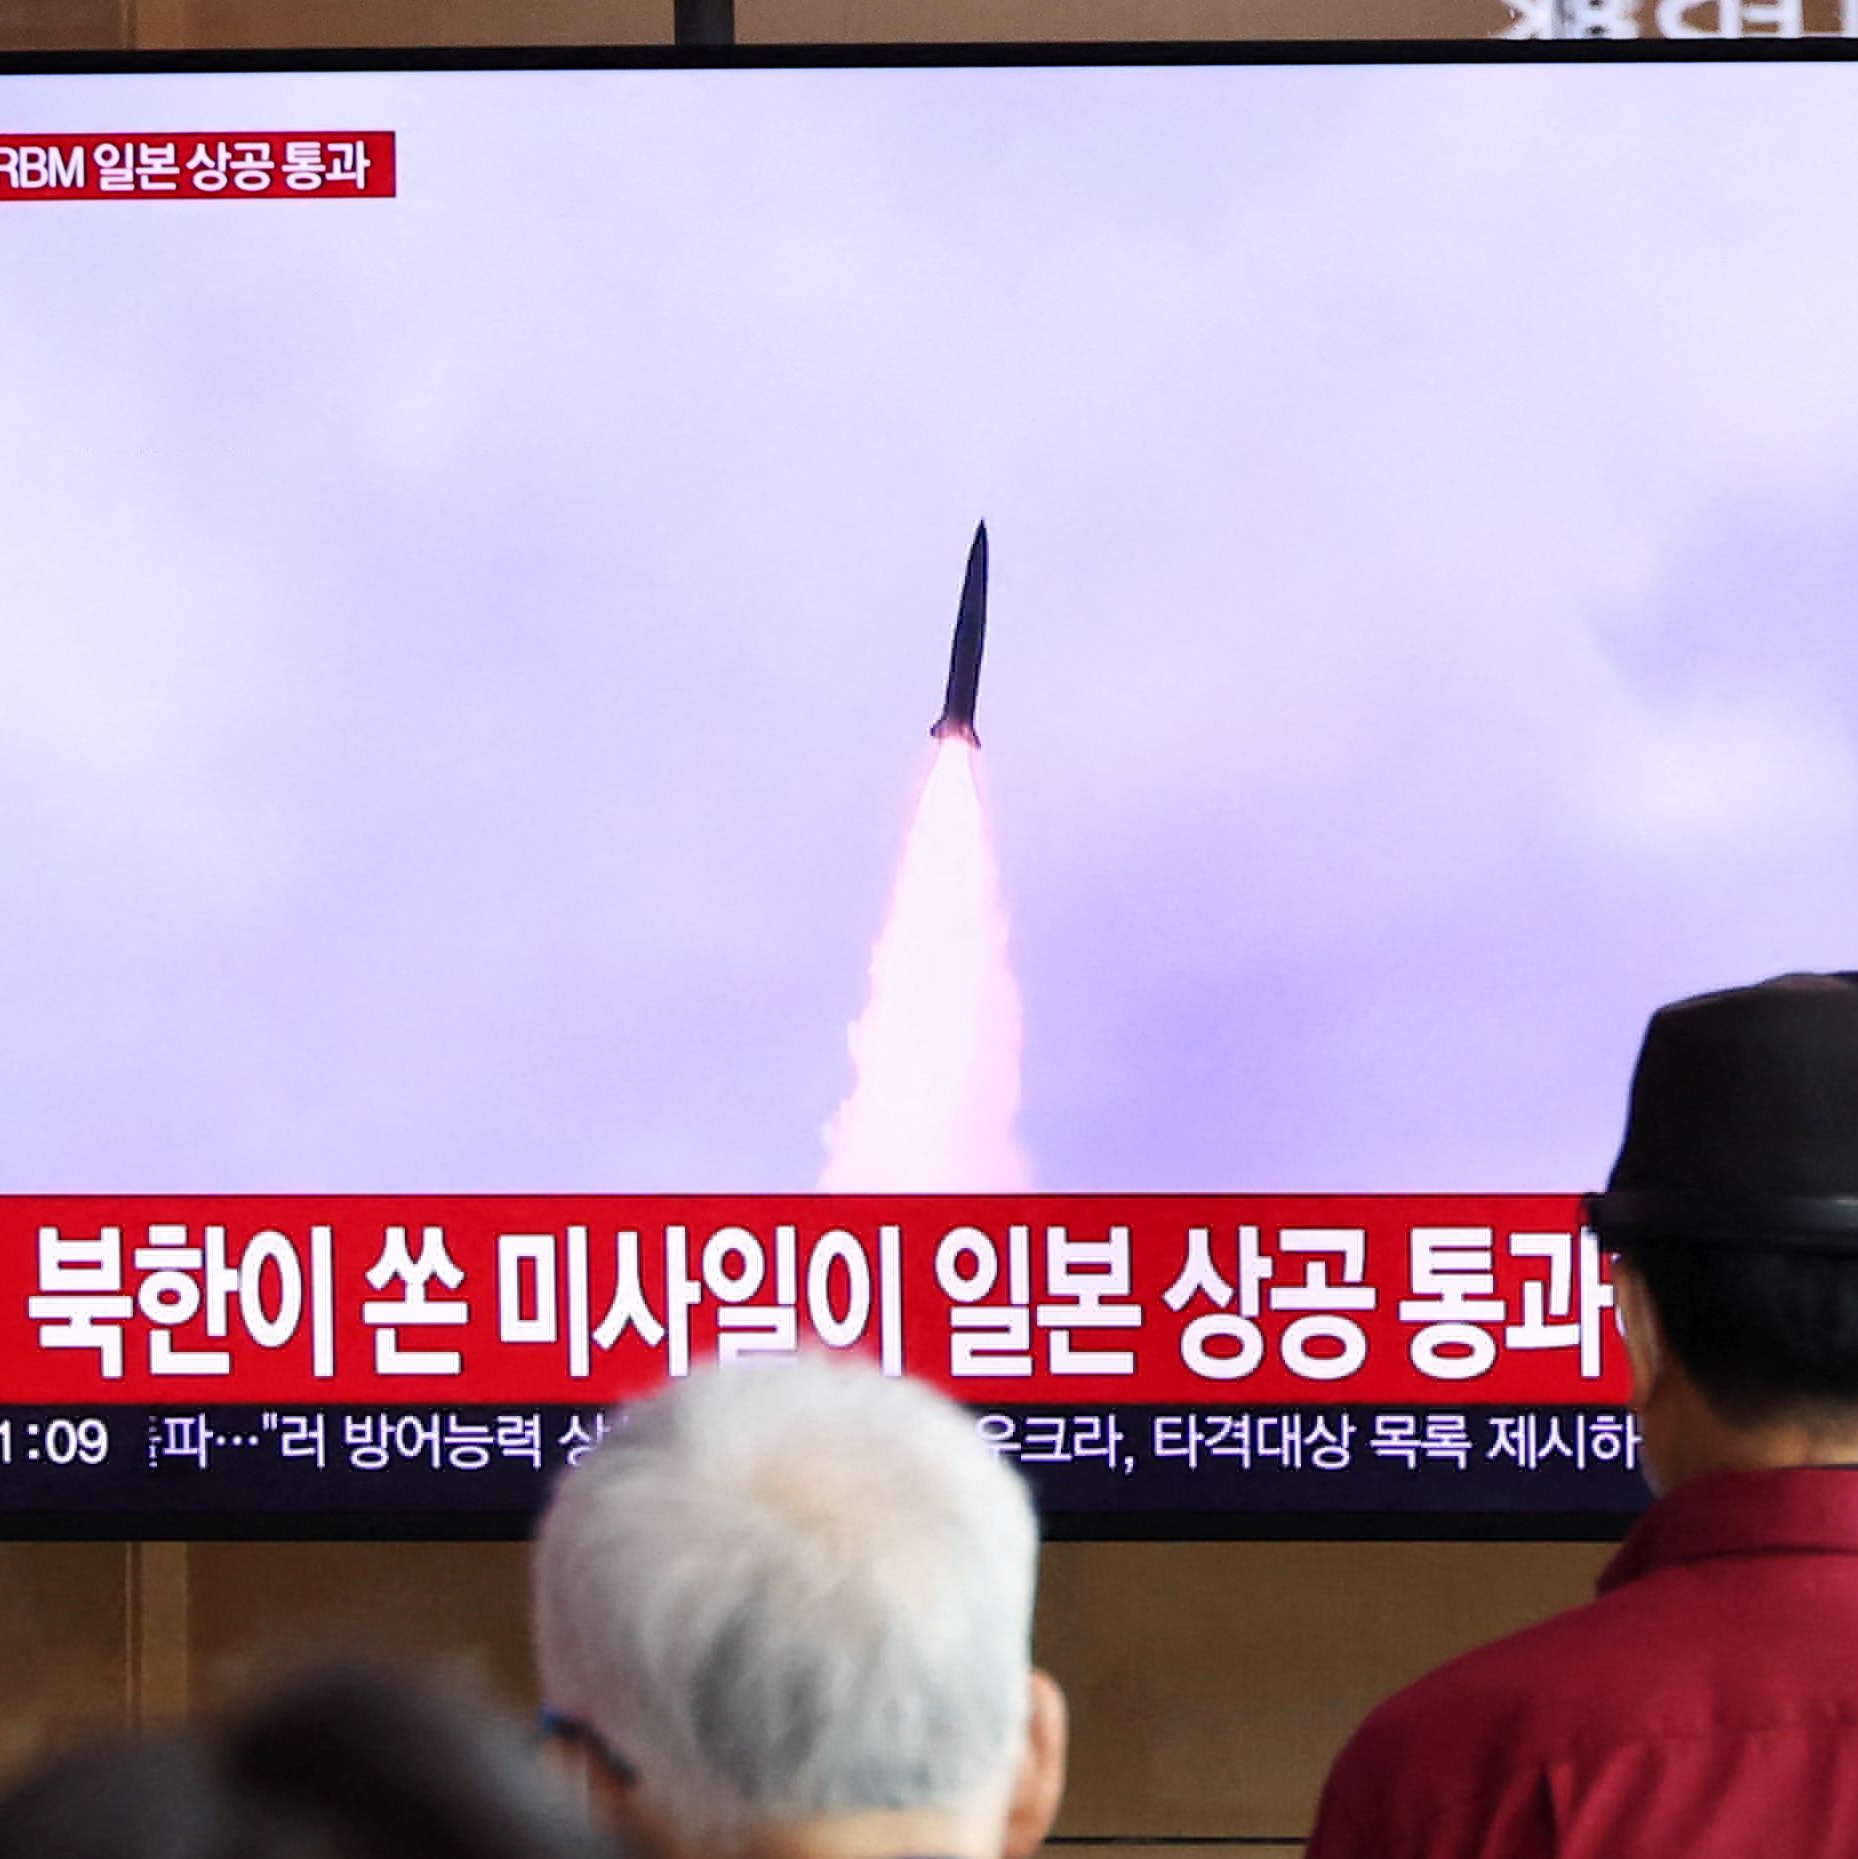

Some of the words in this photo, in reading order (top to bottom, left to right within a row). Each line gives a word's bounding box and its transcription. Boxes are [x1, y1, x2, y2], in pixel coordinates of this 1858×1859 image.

[93, 142, 180, 191] 일본
[186, 141, 275, 192] 상공
[281, 140, 371, 191] 통과
[27, 1224, 334, 1379] 북한이
[362, 1224, 469, 1375] 쏜
[497, 1224, 903, 1378] 미사일이
[934, 1224, 1142, 1378] 일본
[1162, 1224, 1378, 1381] 상공
[344, 1411, 542, 1470] 방어능력
[1154, 1412, 1355, 1470] 타격대상
[1370, 1413, 1472, 1470] 목록
